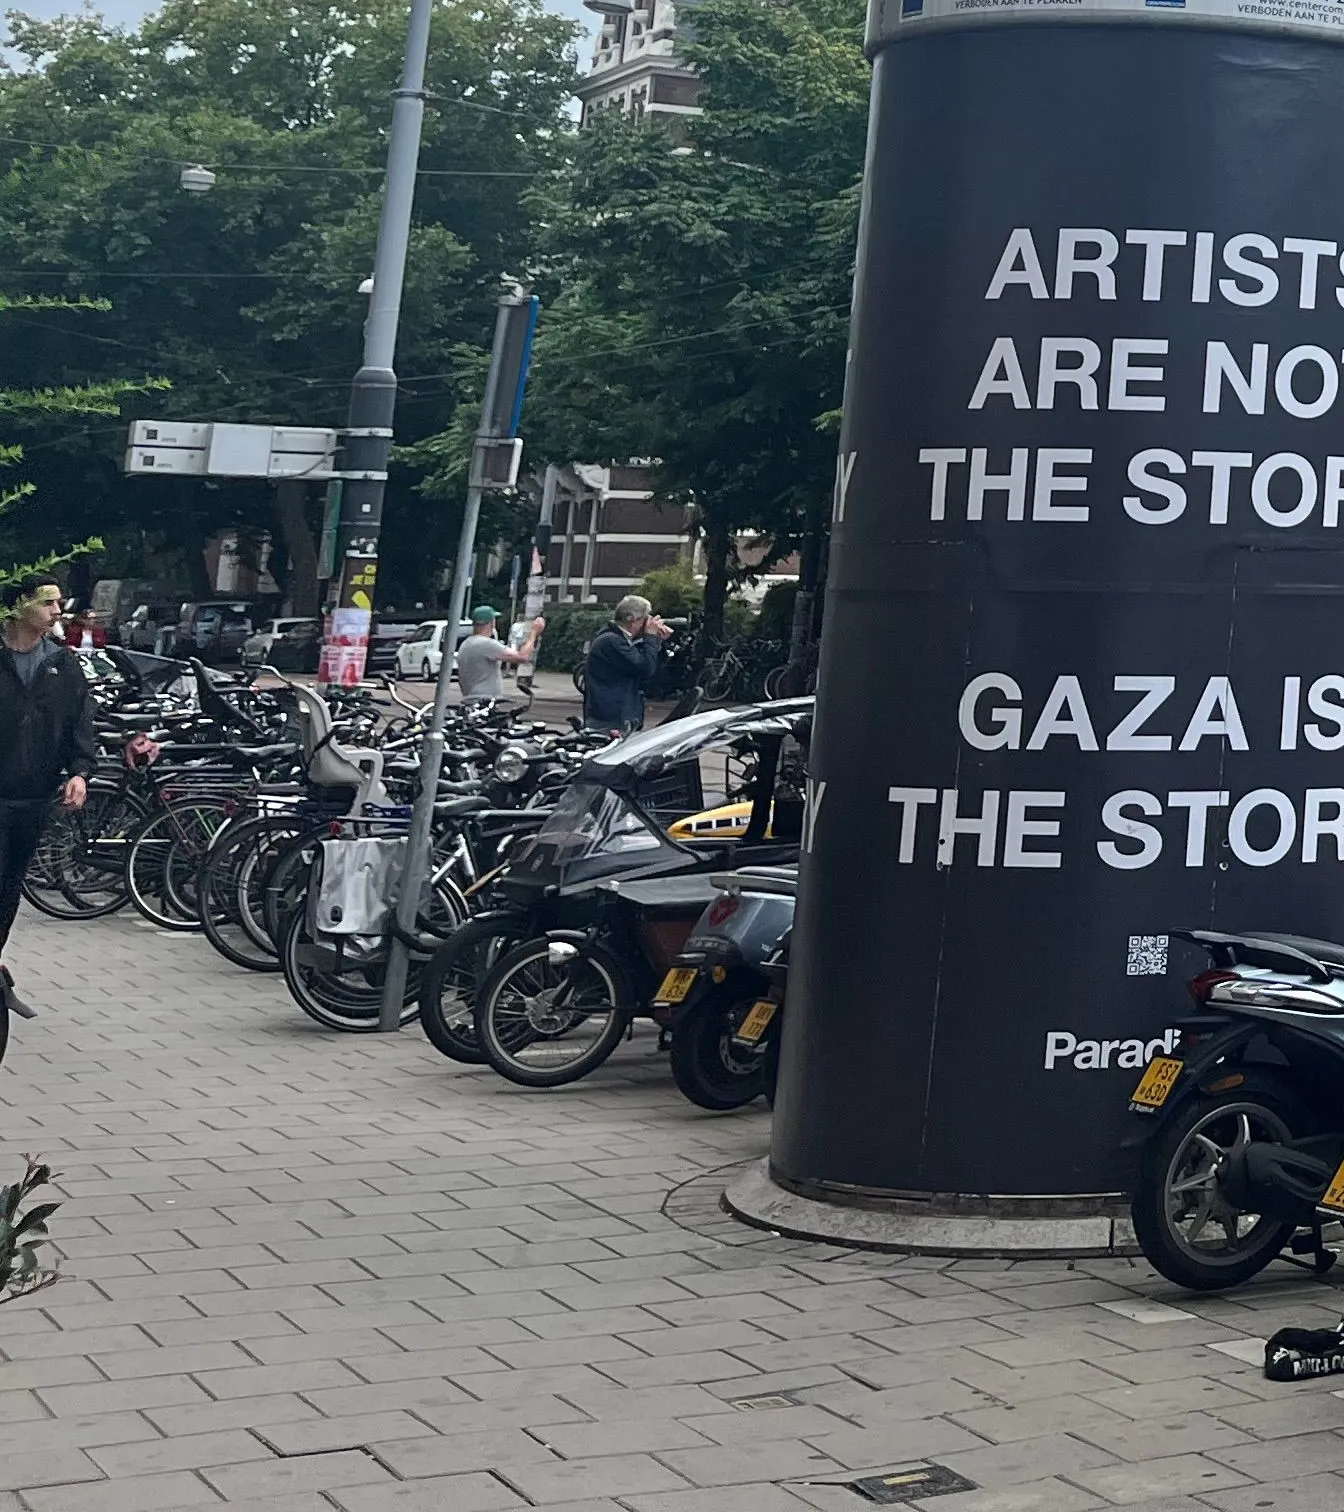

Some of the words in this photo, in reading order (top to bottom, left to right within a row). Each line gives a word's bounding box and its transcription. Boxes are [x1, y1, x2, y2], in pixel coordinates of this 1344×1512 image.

[1237, 3, 1292, 19] VERBODEN
[1294, 9, 1315, 22] AAN
[1317, 12, 1329, 24] TE
[967, 337, 1170, 412] ARE
[918, 447, 1093, 522] THE
[958, 672, 1250, 752] GAZA
[888, 786, 1066, 869] THE
[1044, 1028, 1182, 1070] Paradi
[1153, 1063, 1179, 1082] FSZ
[1144, 1084, 1168, 1101] 63D
